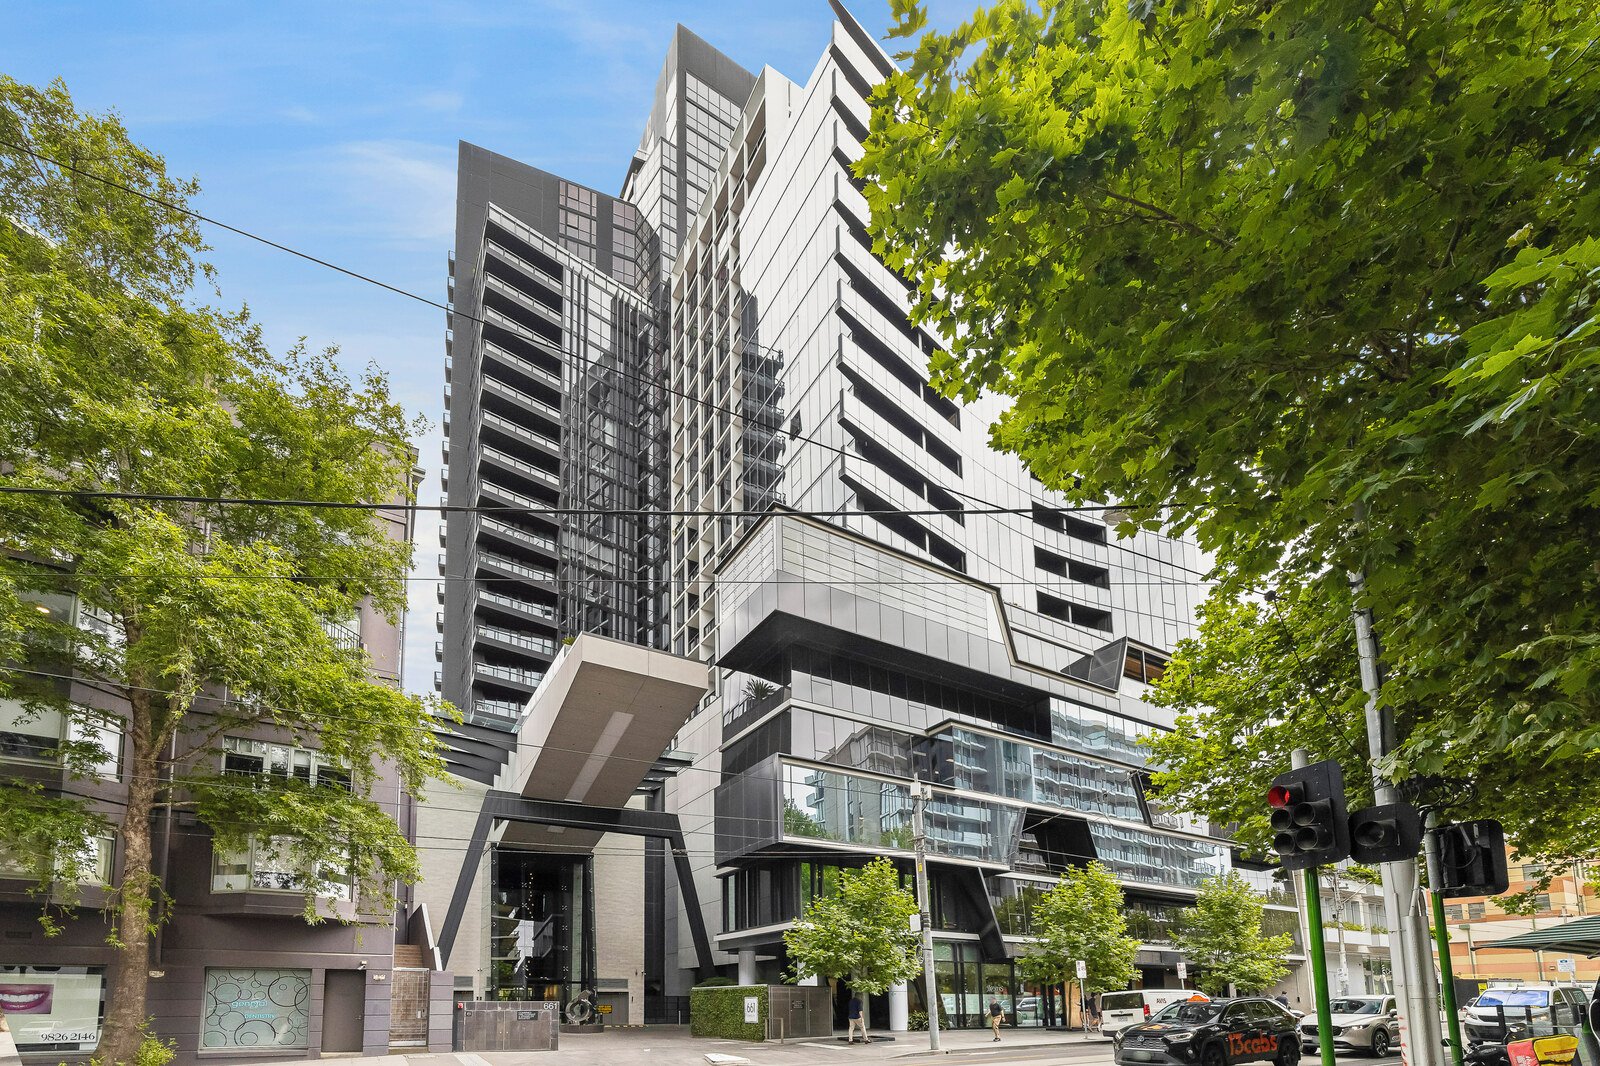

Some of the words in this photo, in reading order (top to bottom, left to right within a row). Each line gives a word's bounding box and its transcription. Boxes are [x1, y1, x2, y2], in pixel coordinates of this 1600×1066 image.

[543, 1002, 558, 1010] 661
[746, 1002, 756, 1013] 661
[40, 1032, 68, 1042] 9826
[70, 1032, 96, 1041] 2146
[1227, 1030, 1279, 1056] 13cabs
